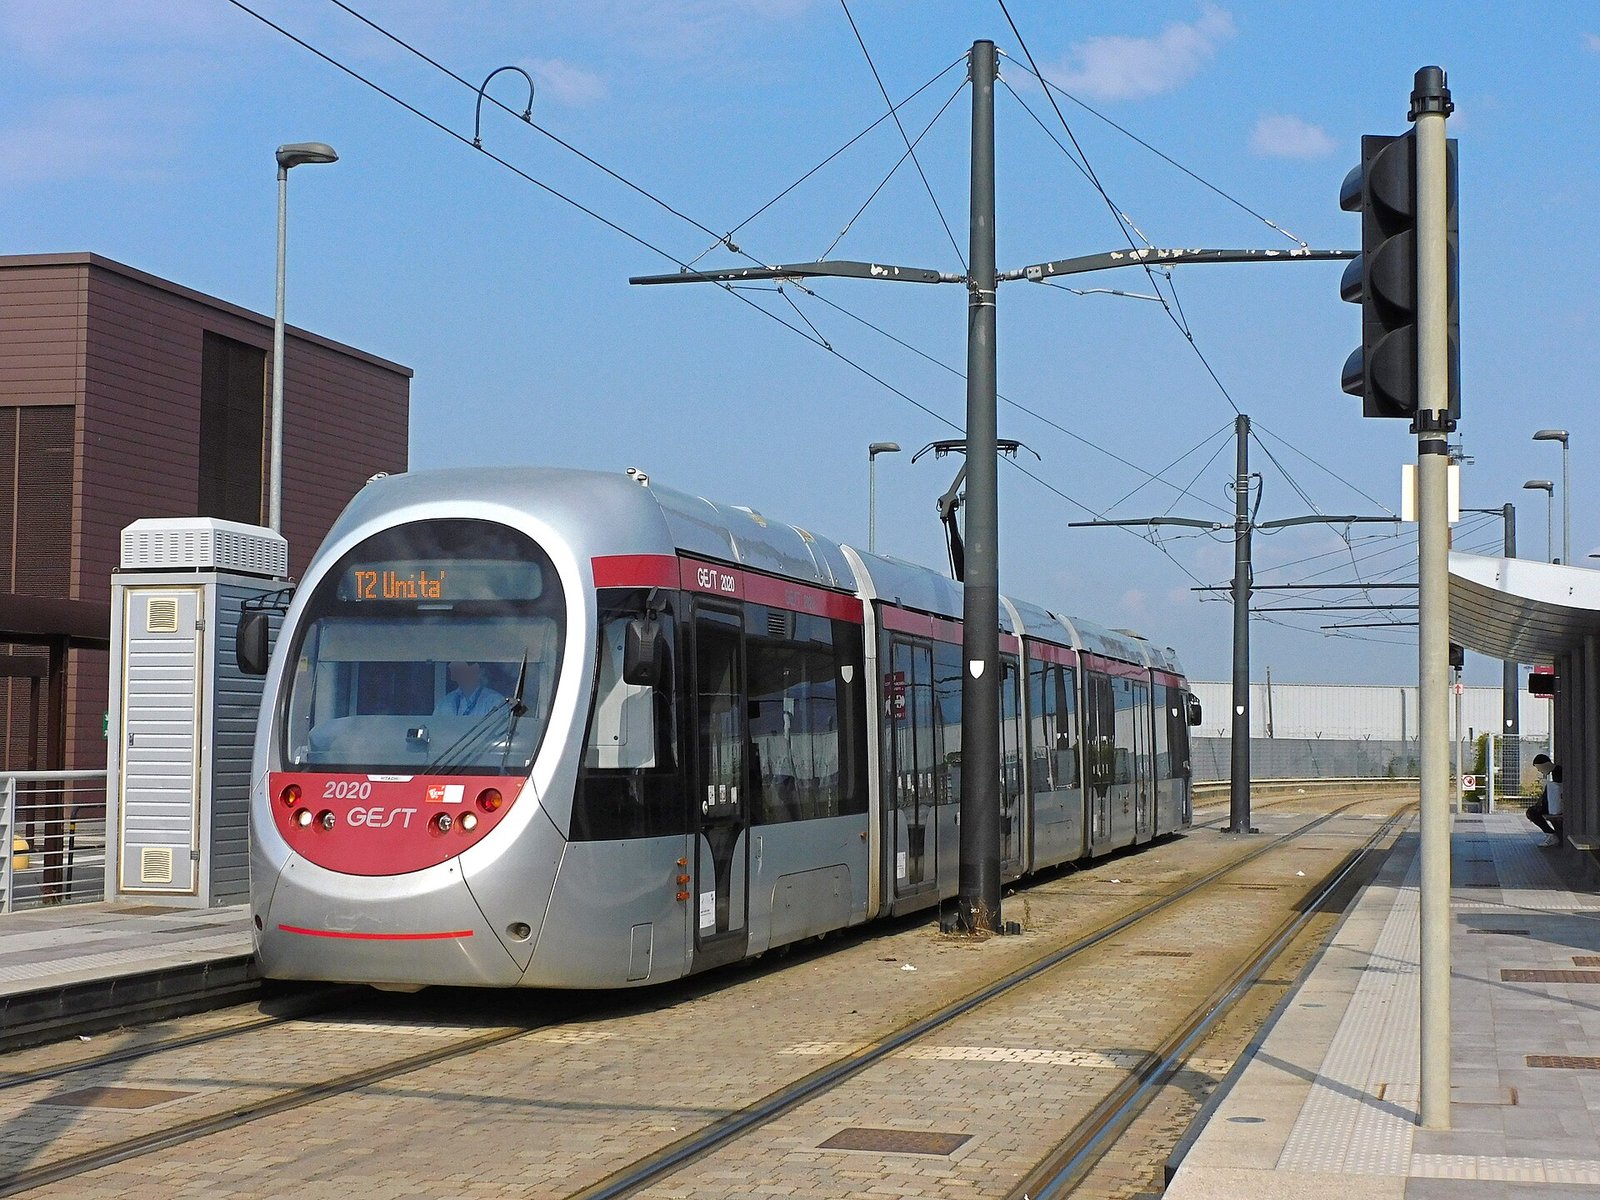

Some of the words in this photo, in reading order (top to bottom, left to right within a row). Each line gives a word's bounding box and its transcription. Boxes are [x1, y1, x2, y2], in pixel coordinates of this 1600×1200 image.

[355, 571, 377, 598] T2
[383, 571, 446, 598] Unita'
[697, 567, 718, 590] GEST
[720, 574, 736, 592] 2020
[322, 781, 372, 800] 2020
[347, 806, 418, 828] GEST
